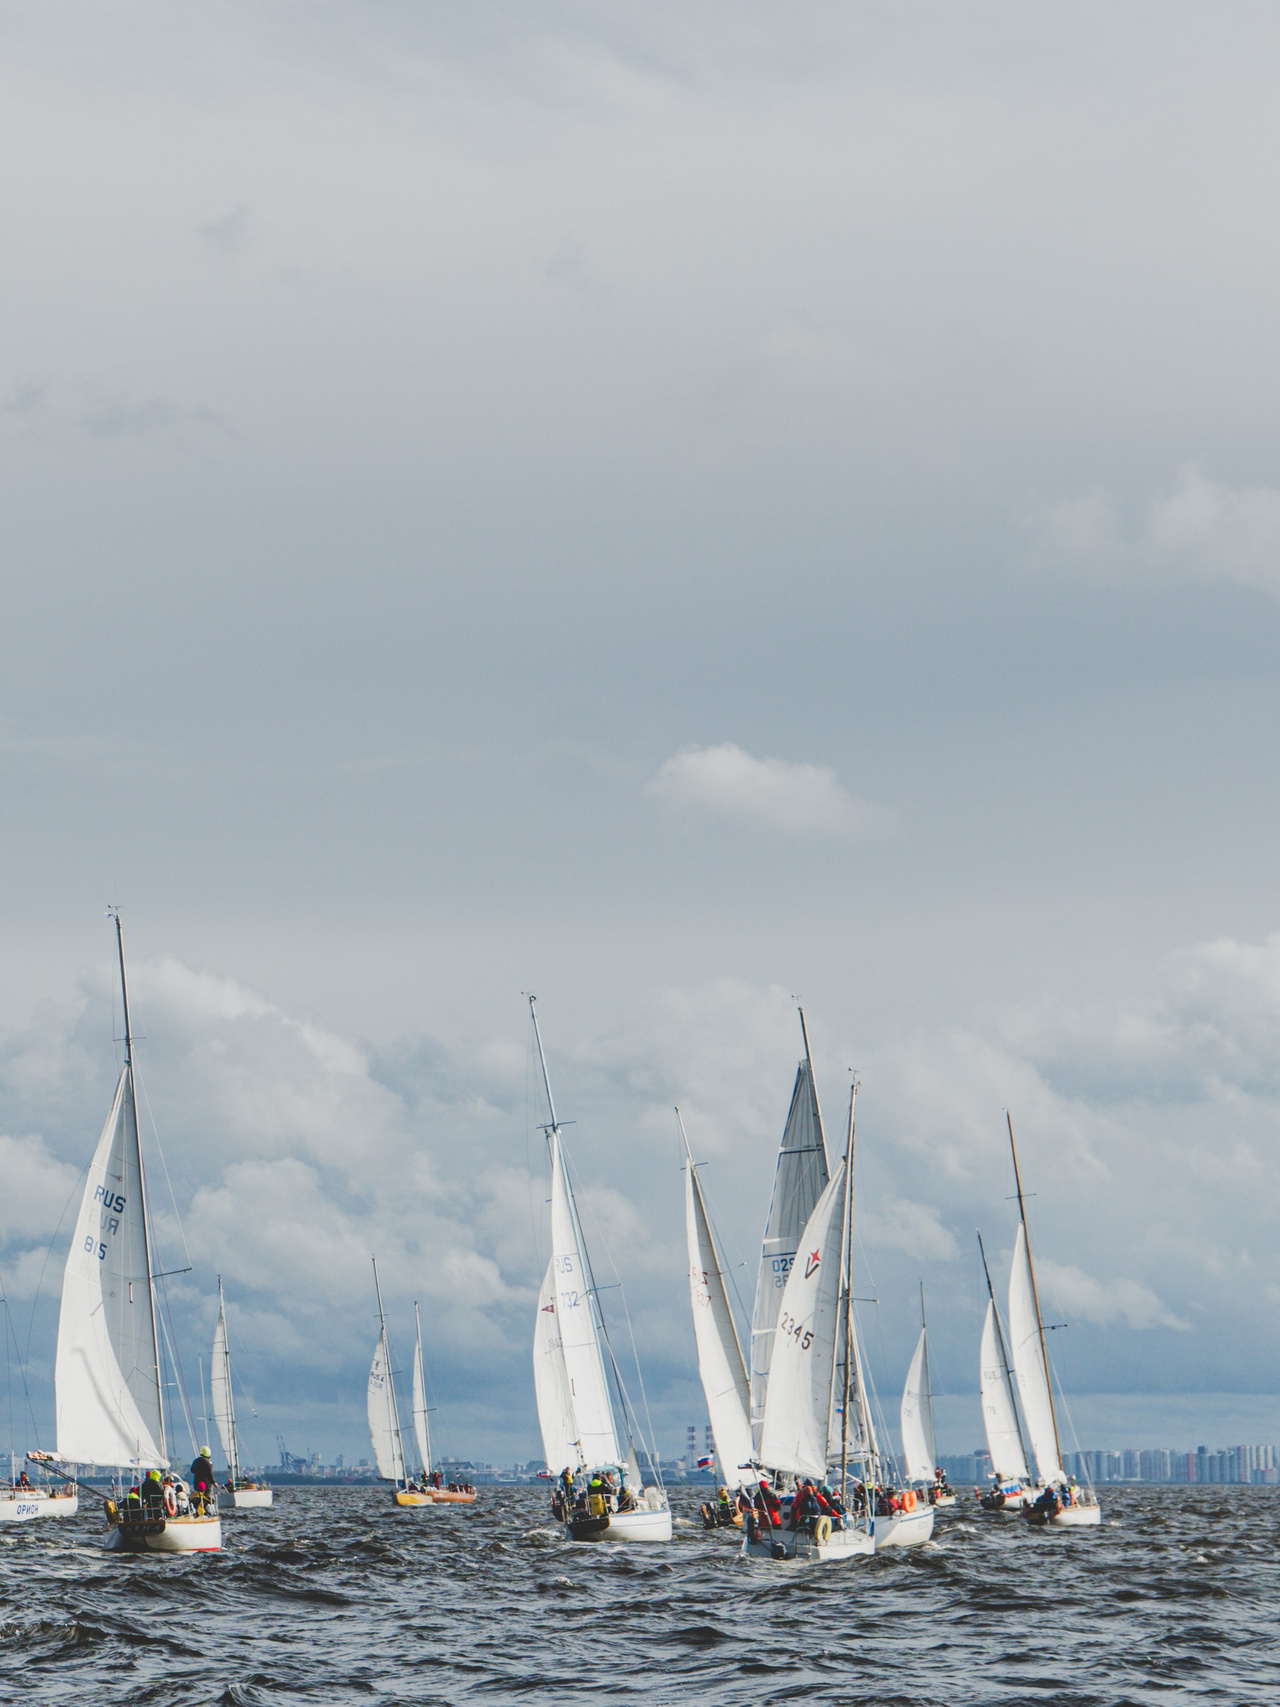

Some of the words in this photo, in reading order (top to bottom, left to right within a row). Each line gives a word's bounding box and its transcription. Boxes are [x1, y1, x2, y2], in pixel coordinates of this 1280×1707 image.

[93, 1185, 127, 1213] RUS
[84, 1236, 107, 1260] 815
[781, 1312, 814, 1350] 2345
